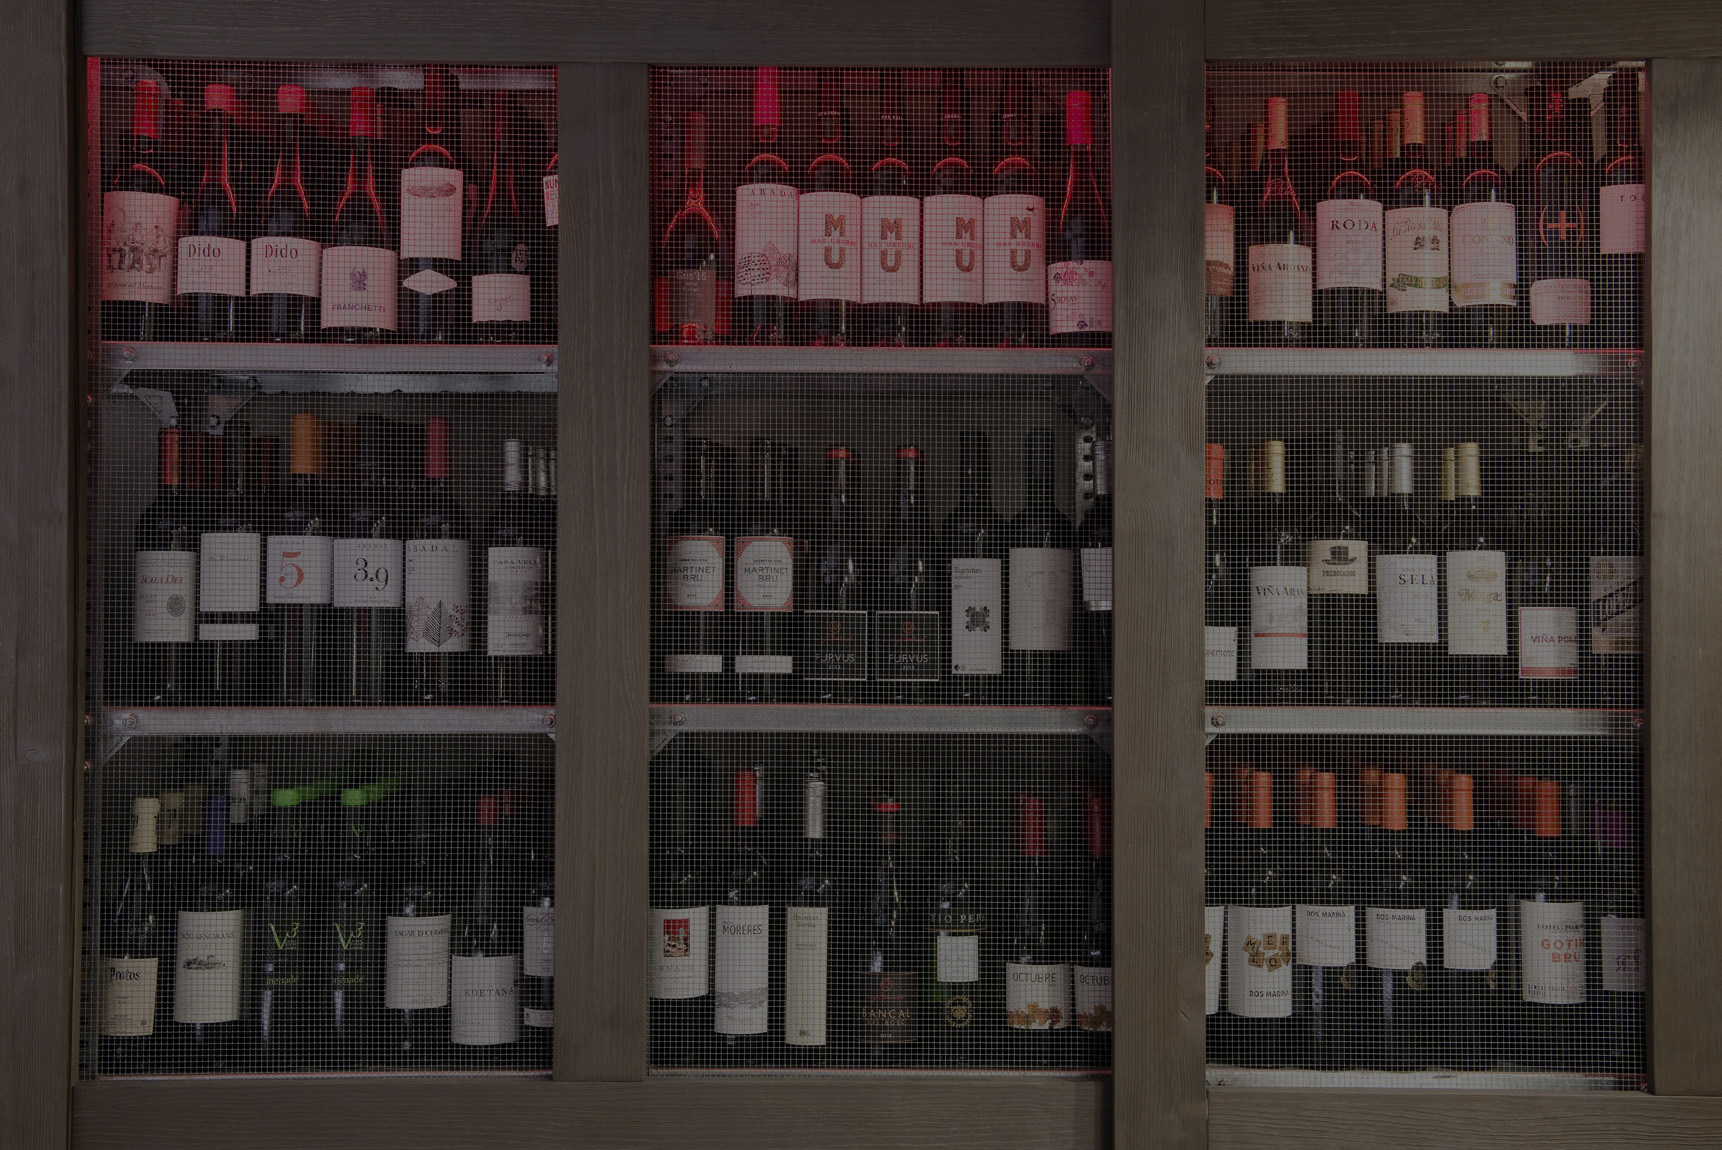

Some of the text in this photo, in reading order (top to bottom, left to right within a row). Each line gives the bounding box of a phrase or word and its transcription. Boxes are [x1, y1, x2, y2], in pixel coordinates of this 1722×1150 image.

[1330, 219, 1378, 232] RODA
[188, 243, 222, 260] Dido
[265, 244, 300, 261] Dido
[331, 303, 386, 314] FRANCHETTI
[278, 550, 304, 590] 5
[353, 556, 389, 591] 3.9
[743, 567, 790, 575] MARTINET
[1398, 573, 1436, 586] SELA
[1530, 633, 1556, 644] VIÑA
[815, 653, 856, 664] FURVUS
[888, 653, 929, 664] FURVUS
[722, 923, 763, 935] MORERES
[107, 966, 141, 983] Protos
[1012, 973, 1056, 983] OCTUBRE
[1249, 990, 1263, 998] ROS
[861, 1008, 911, 1018] BANCAL
